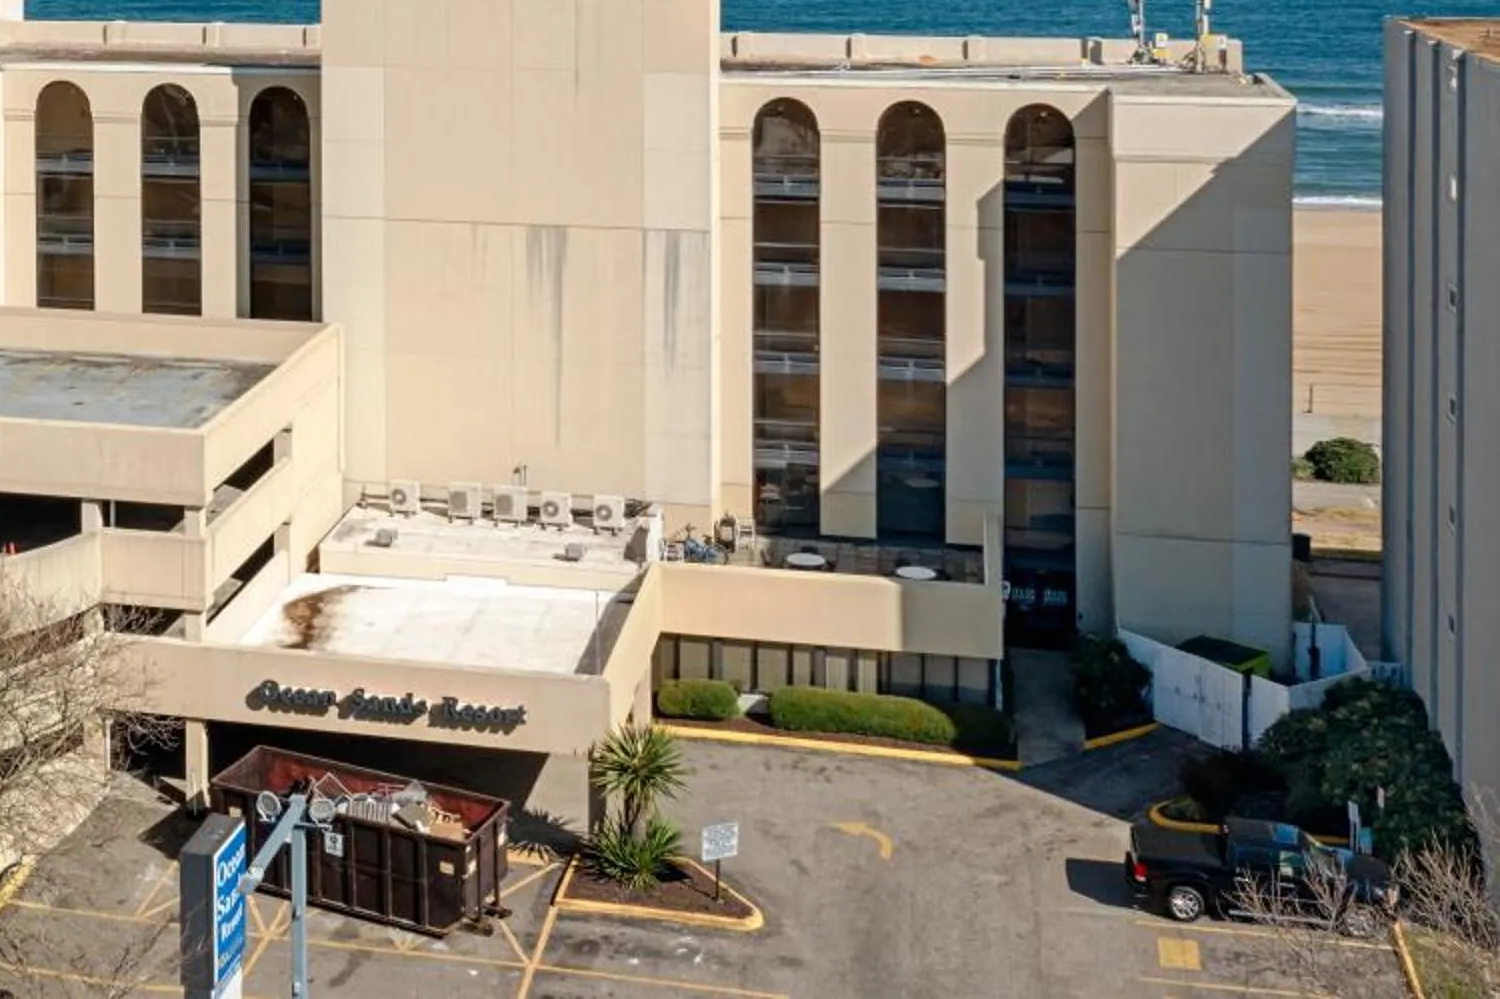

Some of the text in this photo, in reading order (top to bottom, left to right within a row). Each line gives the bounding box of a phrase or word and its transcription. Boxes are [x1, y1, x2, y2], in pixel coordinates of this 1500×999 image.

[257, 679, 526, 728] Ocean Sands Resort
